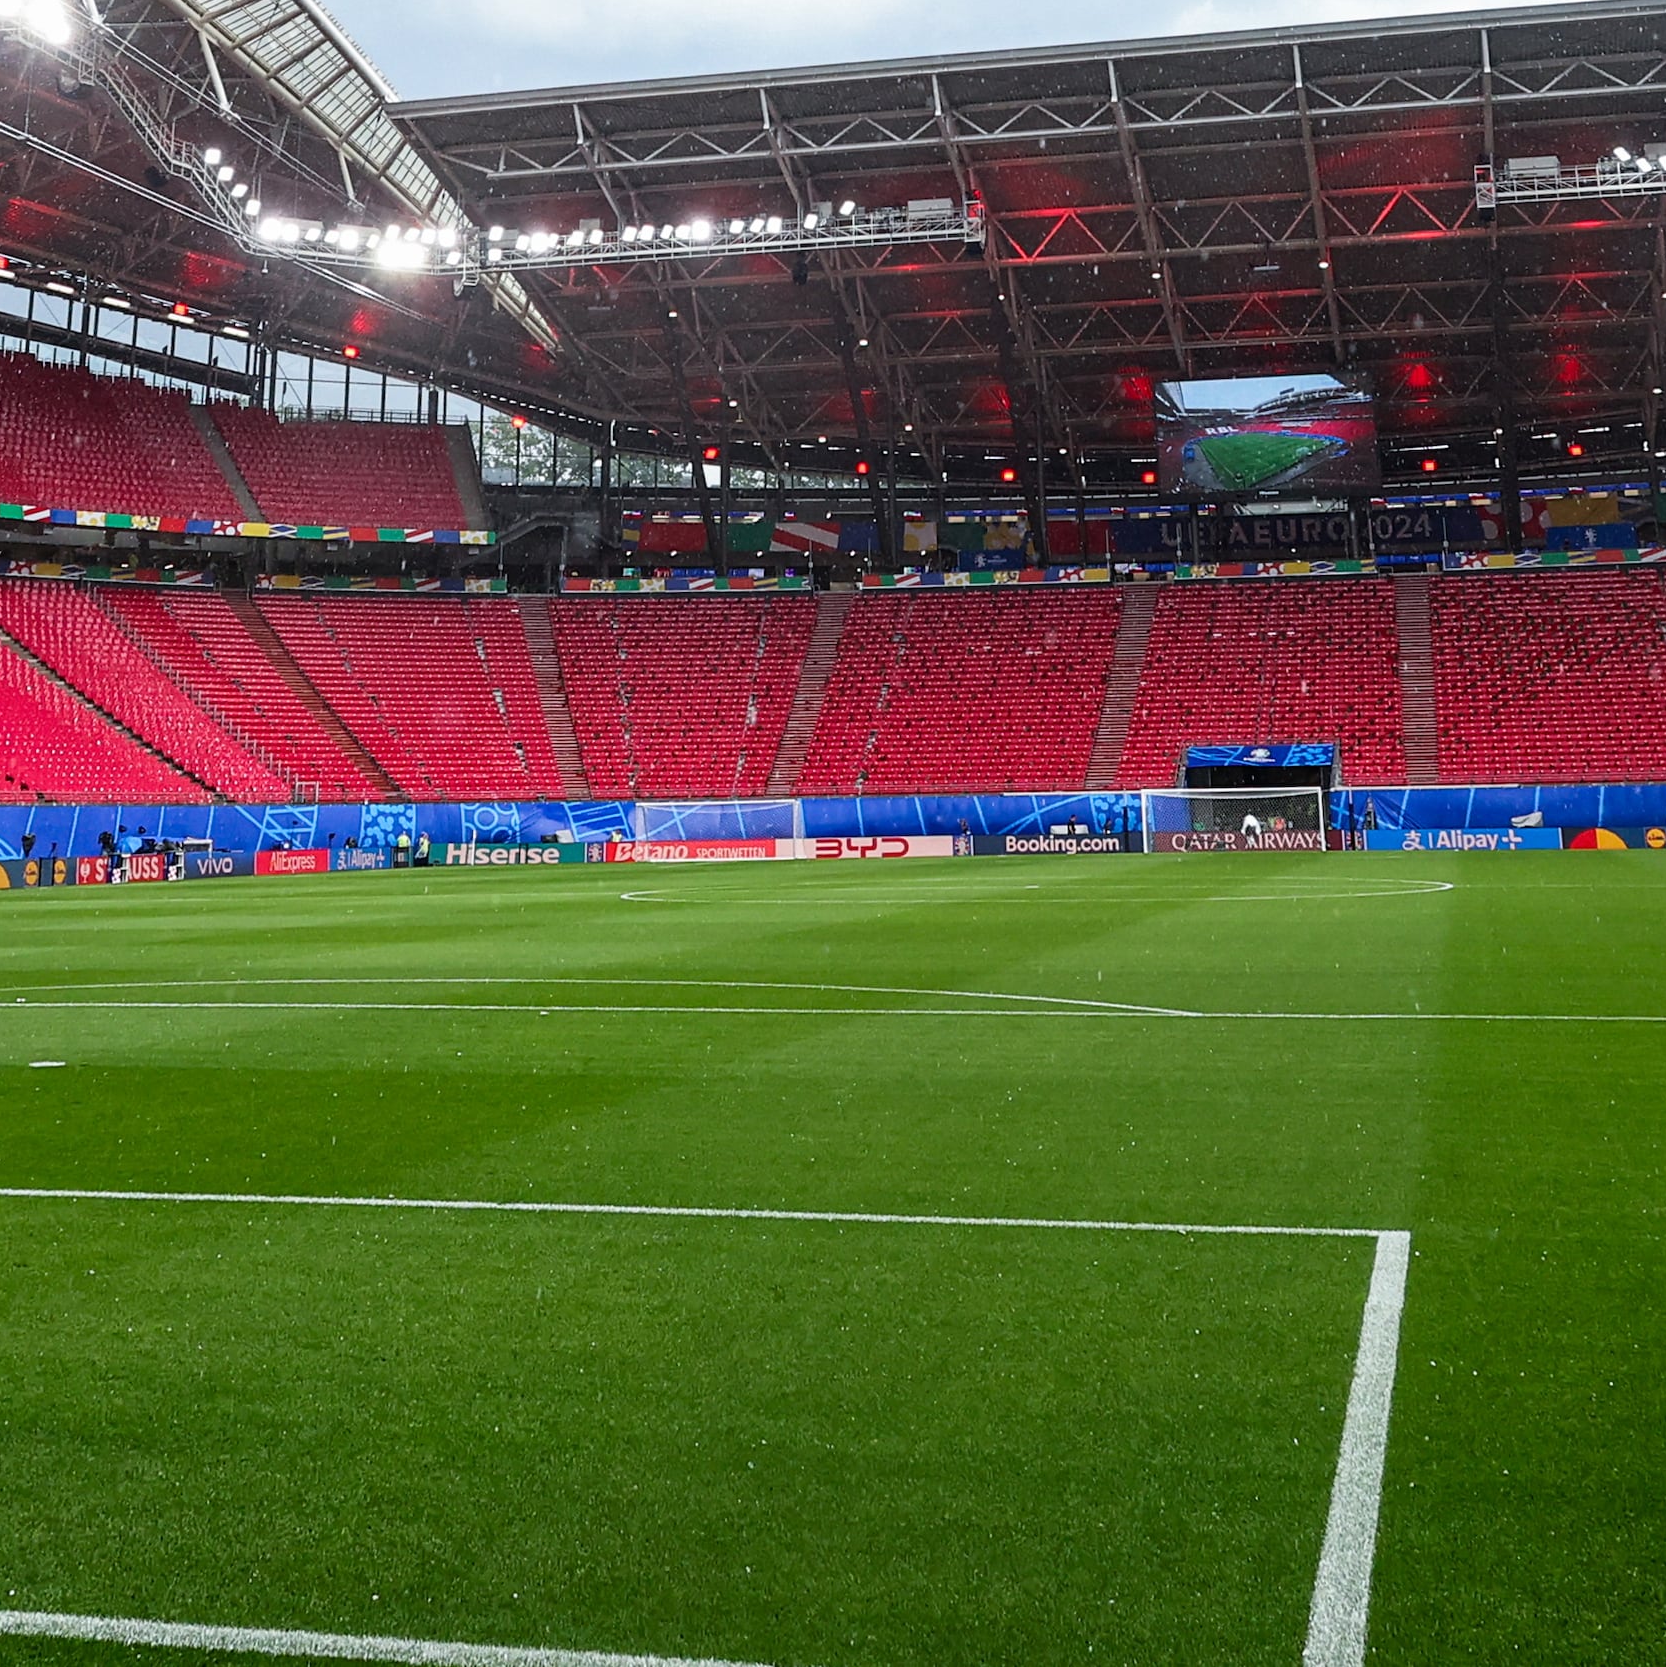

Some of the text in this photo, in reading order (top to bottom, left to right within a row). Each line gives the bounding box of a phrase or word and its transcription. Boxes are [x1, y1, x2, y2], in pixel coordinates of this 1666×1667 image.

[1375, 512, 1432, 540] 024
[445, 843, 560, 865] Hisense
[614, 843, 766, 862] Betano SPORTWETTEN
[1005, 835, 1120, 854] Booking.com
[270, 851, 316, 873] AliExpress
